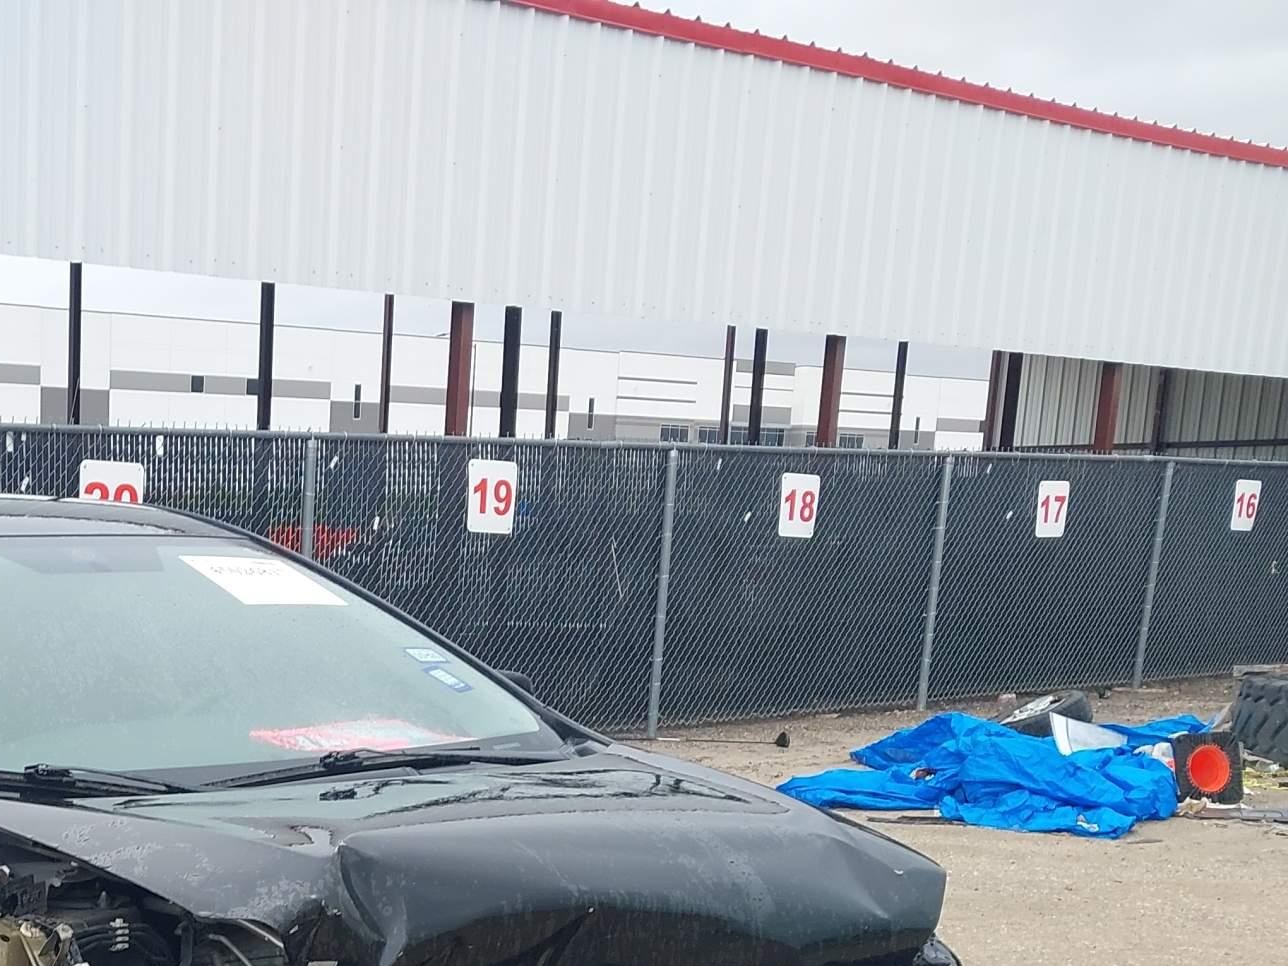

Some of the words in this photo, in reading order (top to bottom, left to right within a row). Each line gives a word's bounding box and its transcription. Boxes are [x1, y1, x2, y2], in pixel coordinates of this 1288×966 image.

[473, 478, 513, 516] 19
[784, 489, 816, 523] 18
[1040, 495, 1067, 524] 17
[1237, 493, 1258, 519] 16
